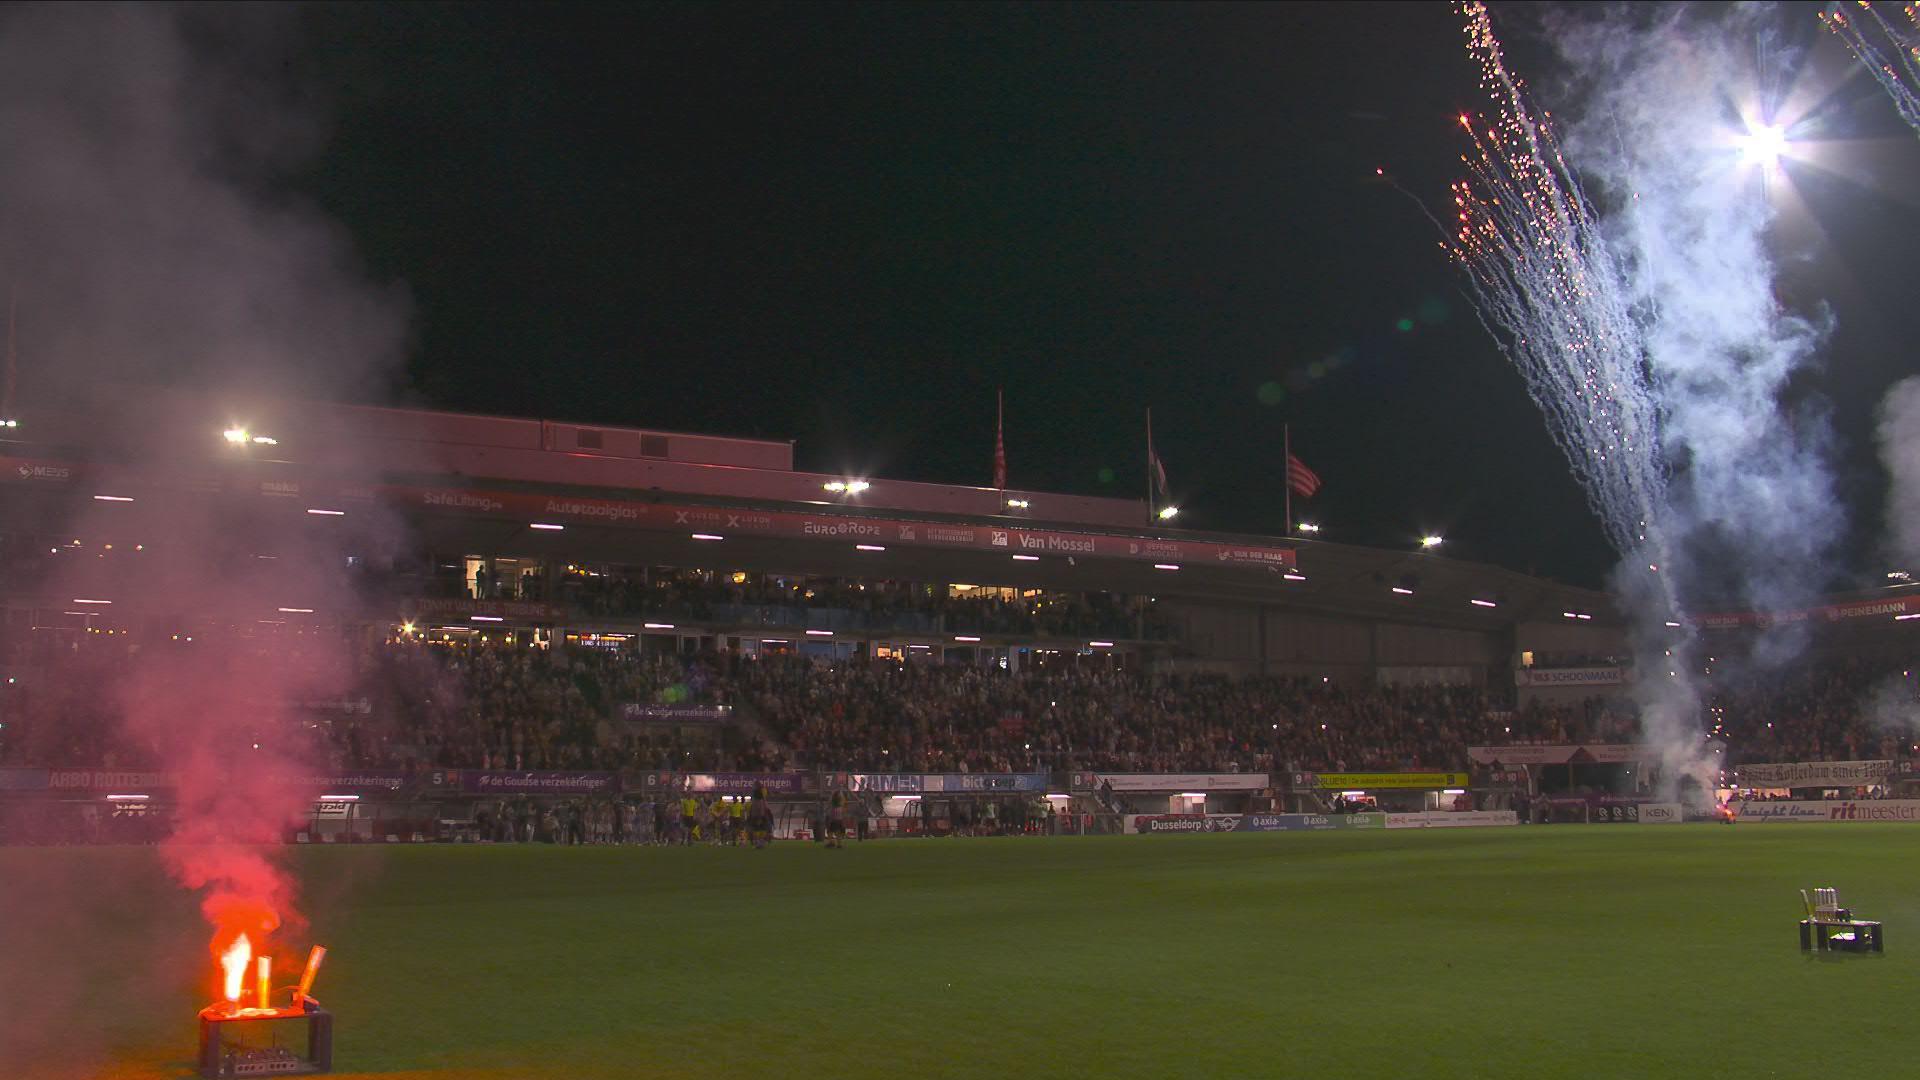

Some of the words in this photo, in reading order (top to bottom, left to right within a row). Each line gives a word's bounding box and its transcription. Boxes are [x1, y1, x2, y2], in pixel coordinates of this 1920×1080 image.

[1019, 533, 1045, 549] Van
[1048, 535, 1095, 552] Mossel
[1263, 552, 1282, 561] HAAS
[1840, 602, 1905, 617] PEINEMANN
[1552, 671, 1618, 682] SCHOONMAAK
[50, 772, 90, 788] ARBO
[432, 772, 443, 785] 5
[490, 775, 503, 785] de
[504, 775, 539, 786] Goudse
[647, 774, 656, 786] 6
[825, 775, 833, 787] 7
[1074, 775, 1081, 785] 8
[1296, 775, 1302, 784] 9
[1645, 809, 1670, 817] KEN
[1831, 800, 1916, 819] ritmeester
[1151, 819, 1202, 831] Dusseldorp
